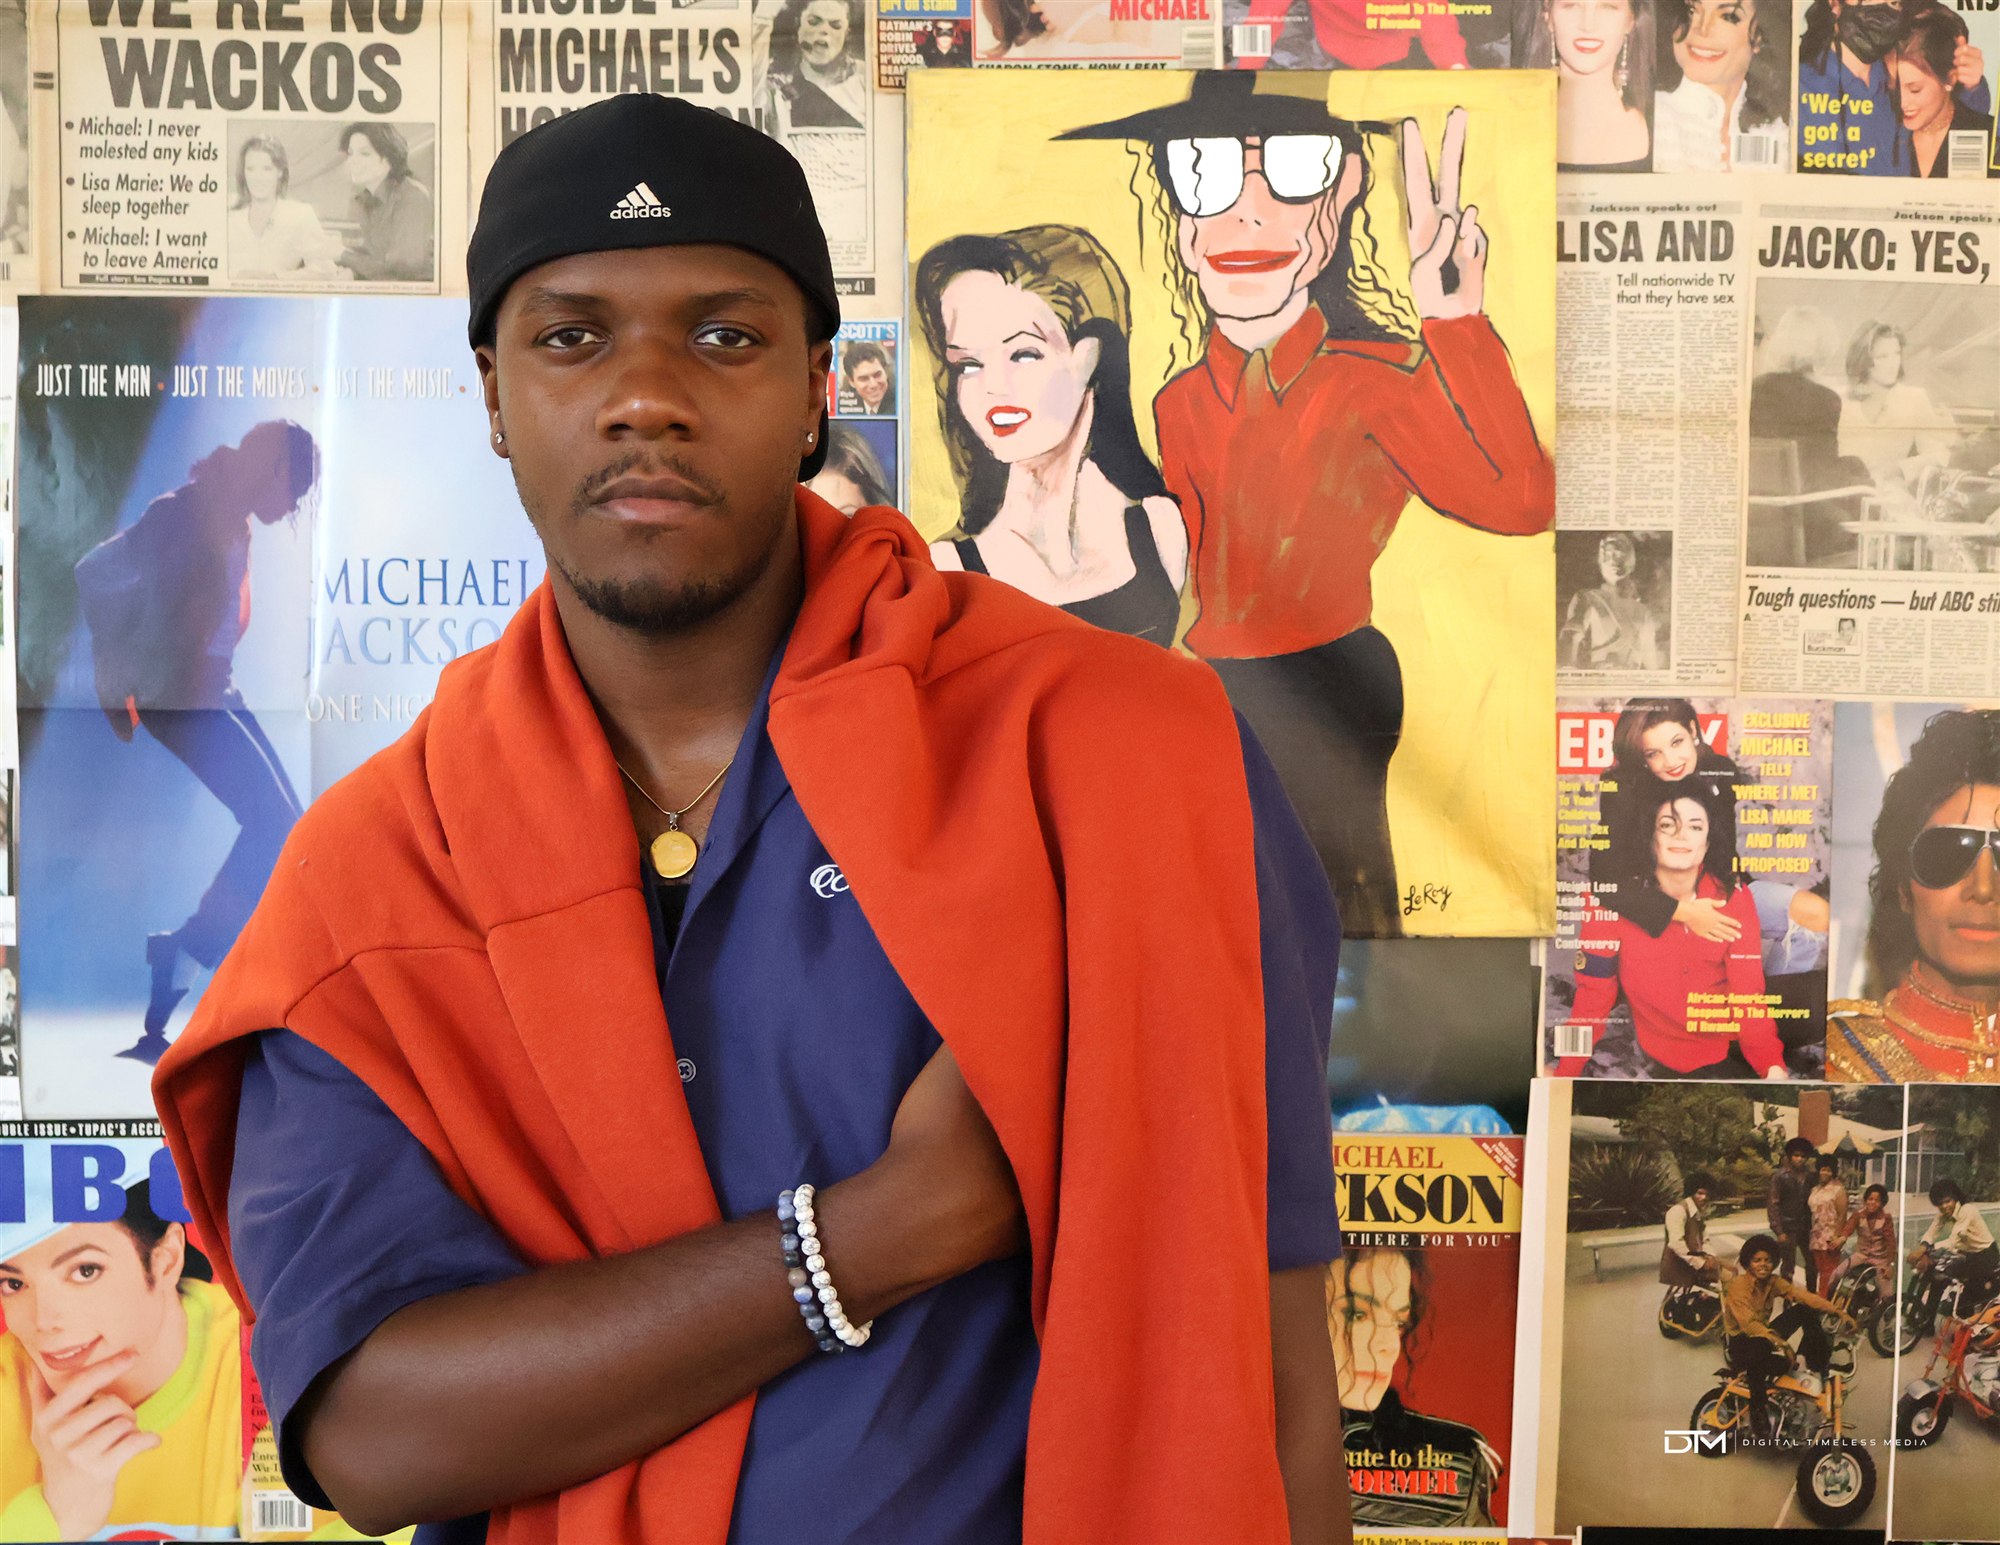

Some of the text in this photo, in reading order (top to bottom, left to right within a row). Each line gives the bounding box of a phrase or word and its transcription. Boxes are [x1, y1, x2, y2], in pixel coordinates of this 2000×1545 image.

[1109, 0, 1211, 21] MICHAEL
[880, 21, 933, 31] BATMAN'S
[880, 32, 913, 43] ROBIN
[880, 43, 917, 54] DRIVES
[500, 28, 741, 94] MICHAEL'S
[100, 37, 402, 114] WACKOS
[1801, 93, 1874, 115] 'We've
[79, 116, 200, 137] Michael: I never
[1804, 122, 1861, 146] got a
[80, 140, 218, 166] molested any kids
[1803, 148, 1876, 168] secret'
[82, 172, 218, 193] Lisa Marie: We do
[82, 194, 189, 220] sleep together
[610, 205, 671, 219] adidas
[1590, 204, 1717, 214] Jackson speaks out
[1894, 211, 1993, 224] Jackson speaks
[83, 226, 207, 247] Michael: I want
[1556, 220, 1734, 263] LISA AND
[83, 248, 218, 270] to leave America
[1758, 225, 1990, 284] JACKO: YES,
[835, 281, 865, 296] age 41
[1617, 274, 1735, 287] Tell nationwide TV
[1617, 291, 1735, 307] that they have sex
[839, 323, 896, 339] SCOTT'S
[36, 364, 150, 397] JUST THE MAN
[172, 365, 306, 398] JUST THE MOVES
[369, 368, 395, 399] THE
[403, 368, 454, 399] MUSIC
[1747, 586, 1793, 611] Tough
[1798, 589, 1876, 612] questions
[1909, 590, 1938, 611] but
[1940, 591, 1975, 612] ABC
[304, 694, 363, 722] ONE
[1744, 713, 1810, 728] EXCLUSIVE
[1740, 738, 1811, 757] MICHAEL
[1760, 763, 1792, 777] TELLS
[1584, 782, 1595, 792] To
[1599, 781, 1618, 792] Talk
[1731, 785, 1818, 801] 'WHERE I MET
[1559, 795, 1597, 806] To Your
[1558, 809, 1601, 820] Children
[1740, 809, 1813, 825] LISA MARIE
[1558, 824, 1587, 835] About
[1557, 837, 1611, 851] And Drugs
[1746, 833, 1807, 849] AND HOW
[1732, 857, 1814, 873] I PROPOSED'
[1557, 881, 1618, 894] Weight Loss
[1403, 883, 1453, 916] LeRoy
[1588, 895, 1600, 907] To
[1556, 910, 1619, 923] Beauty Title
[1555, 938, 1621, 951] Controversy
[1687, 992, 1782, 1004] African-Americans
[1686, 1006, 1810, 1019] Respond To The Horrors
[1686, 1021, 1741, 1032] Of Rwanda
[0, 1123, 29, 1136] UBLE
[34, 1123, 68, 1136] ISSUE
[77, 1122, 127, 1136] TUPAC'S
[1348, 1233, 1410, 1246] THERE
[1421, 1234, 1454, 1246] FOR
[1344, 1444, 1453, 1468] ute to the
[1348, 1469, 1460, 1495] ORMER
